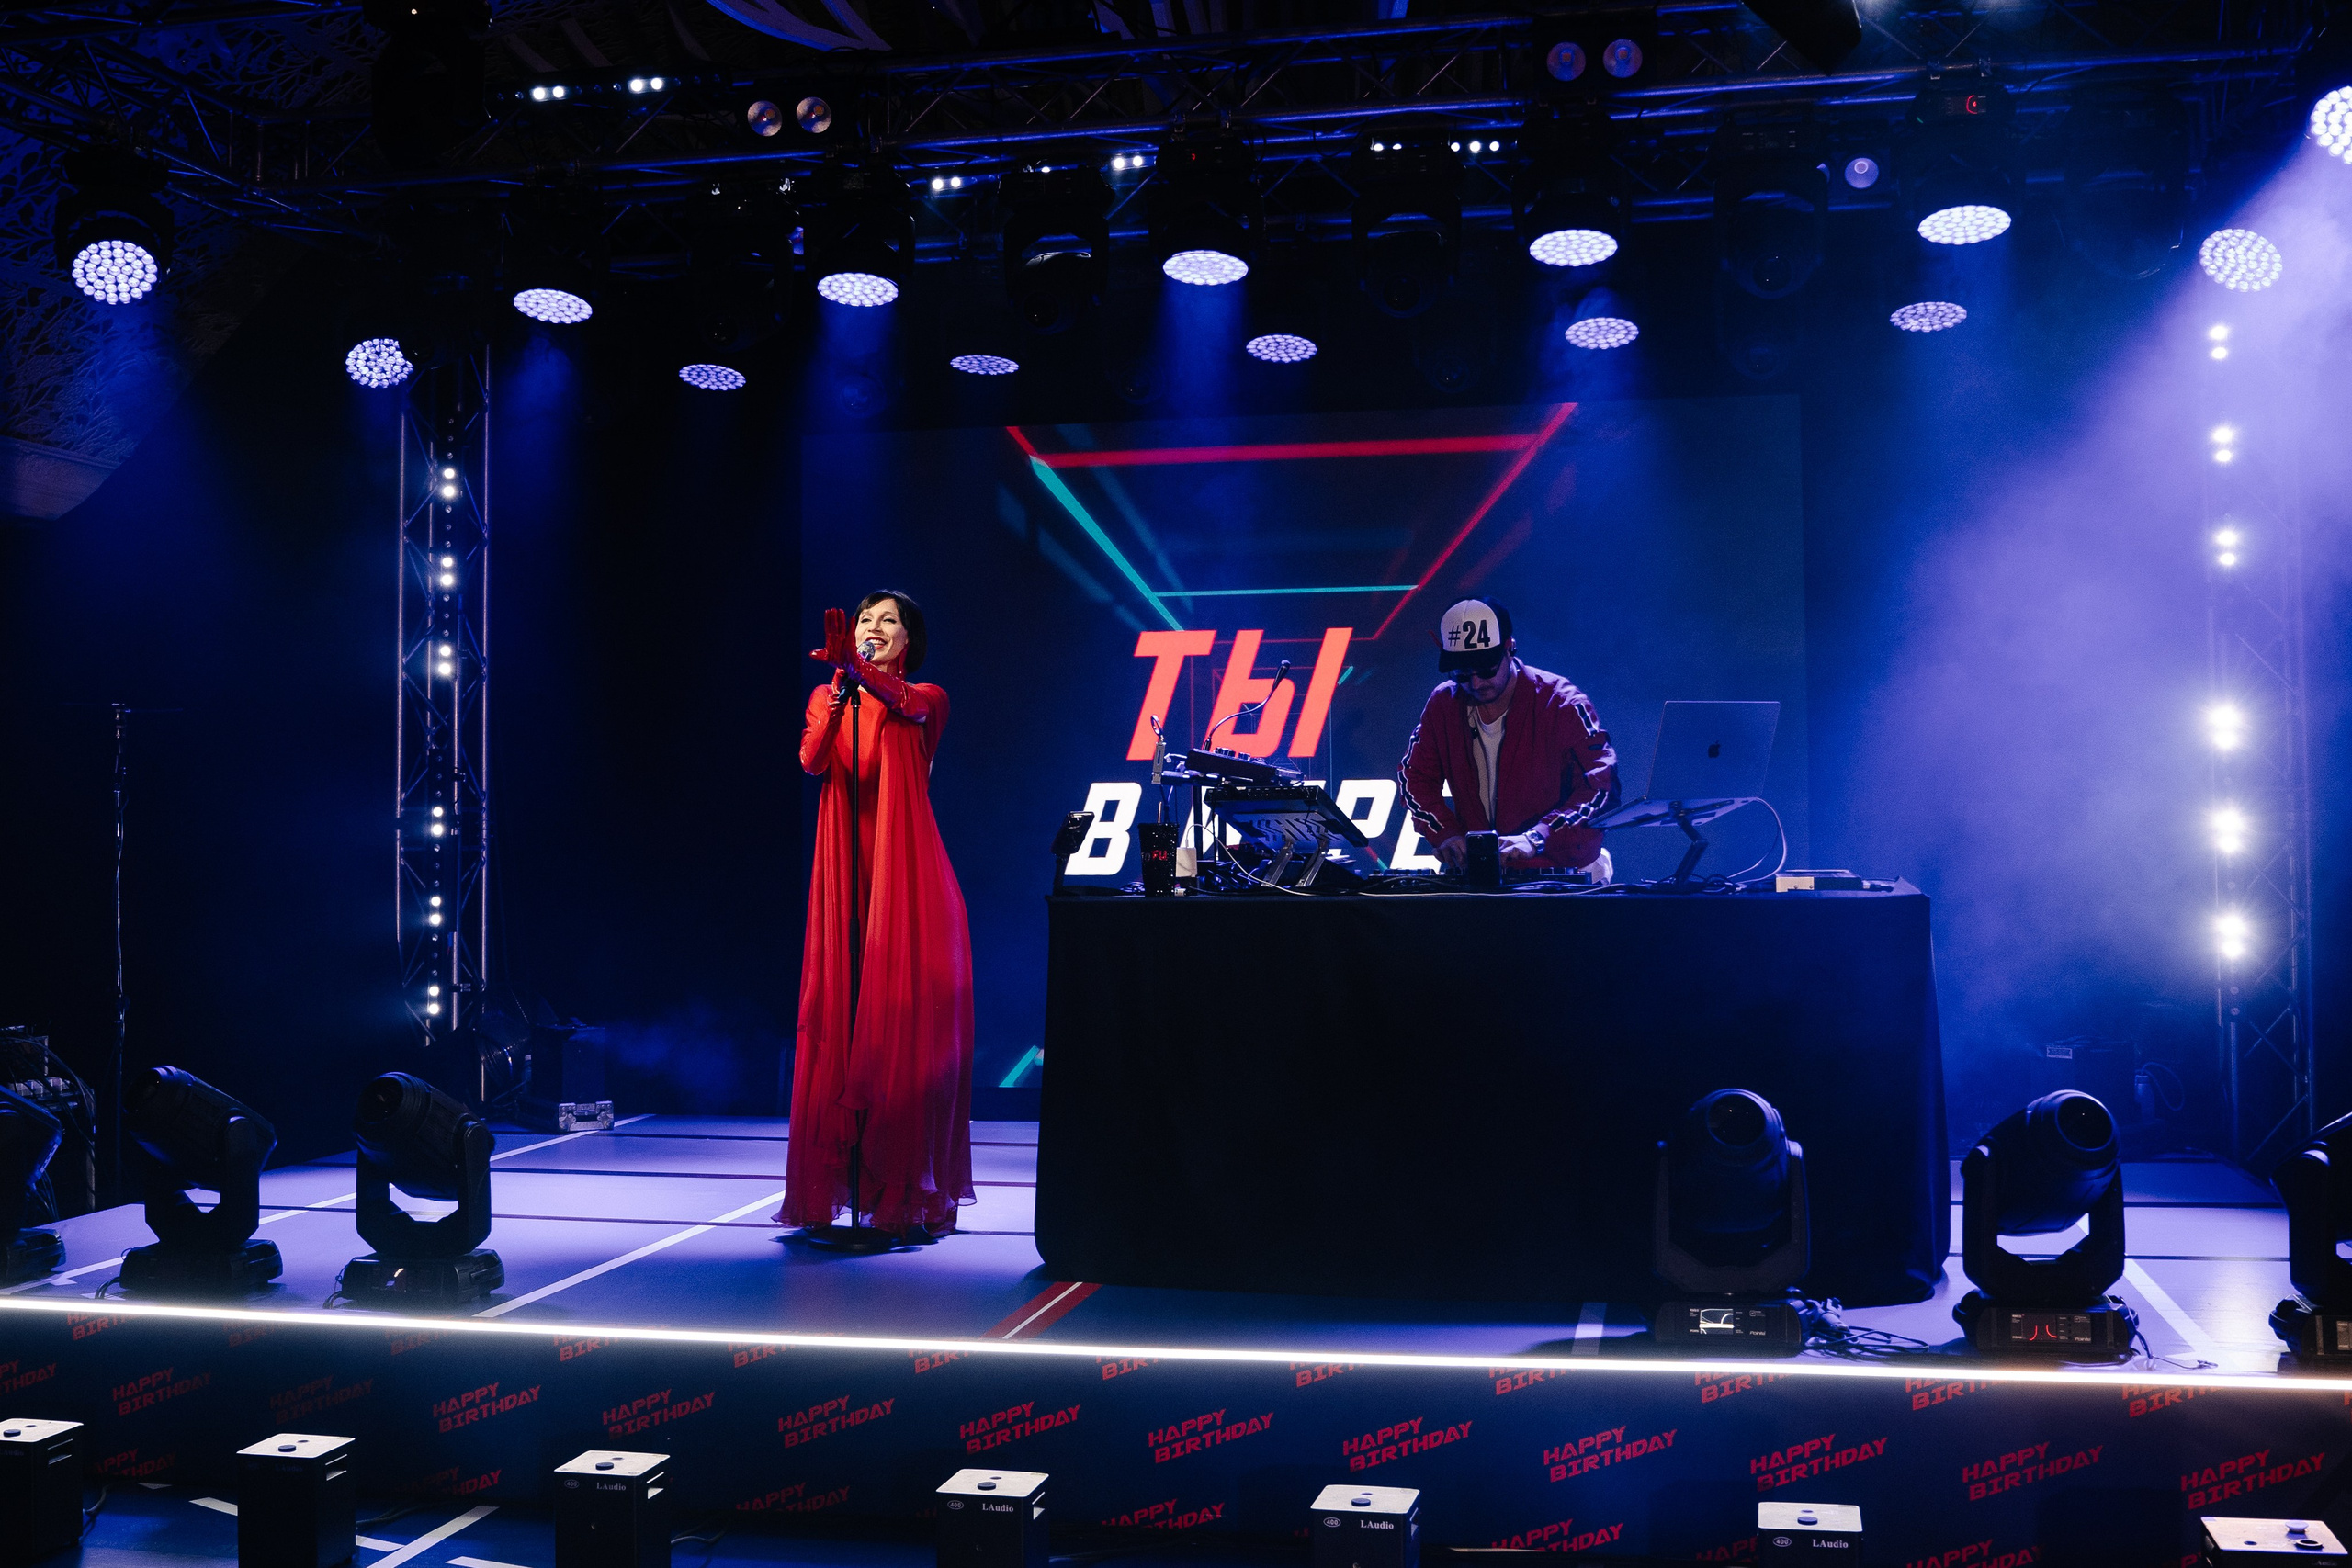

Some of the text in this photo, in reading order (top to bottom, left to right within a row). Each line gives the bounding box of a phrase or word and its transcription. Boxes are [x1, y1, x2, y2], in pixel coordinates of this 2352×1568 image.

[1447, 619, 1491, 649] #24
[1125, 626, 1353, 761] ТЫ
[1064, 781, 1143, 876] В
[0, 1362, 57, 1394] THDAY
[112, 1366, 175, 1402] HAPPY
[118, 1371, 213, 1416] BIRTHDAY
[432, 1382, 500, 1418] HAPPY
[438, 1384, 541, 1434] BIRTHDAY
[602, 1388, 673, 1426] HAPPY
[608, 1391, 716, 1440] BIRTHDAY
[777, 1394, 851, 1433] HAPPY
[959, 1401, 1035, 1439] HAPPY
[784, 1398, 896, 1449] BIRTHDAY
[966, 1404, 1082, 1455] BIRTHDAY
[1148, 1408, 1227, 1448] HAPPY
[1154, 1412, 1274, 1464] BIRTHDAY
[1342, 1416, 1424, 1456] HAPPY
[1349, 1420, 1473, 1472] BIRTHDAY
[1543, 1425, 1627, 1466] HAPPY
[1549, 1428, 1679, 1483] BIRTHDAY
[1749, 1433, 1837, 1475] HAPPY
[1756, 1437, 1889, 1494] BIRTHDAY
[1962, 1441, 2051, 1483] HAPPY
[596, 1482, 627, 1491] LAudio
[1968, 1445, 2104, 1502] BIRTHDAY
[2180, 1449, 2271, 1493] HAPPY
[2187, 1452, 2326, 1511] BIRTHDAY
[981, 1503, 1014, 1513] LAudio
[1326, 1517, 1395, 1530] 400 LAudio
[1775, 1538, 1849, 1550] 400 LAudio
